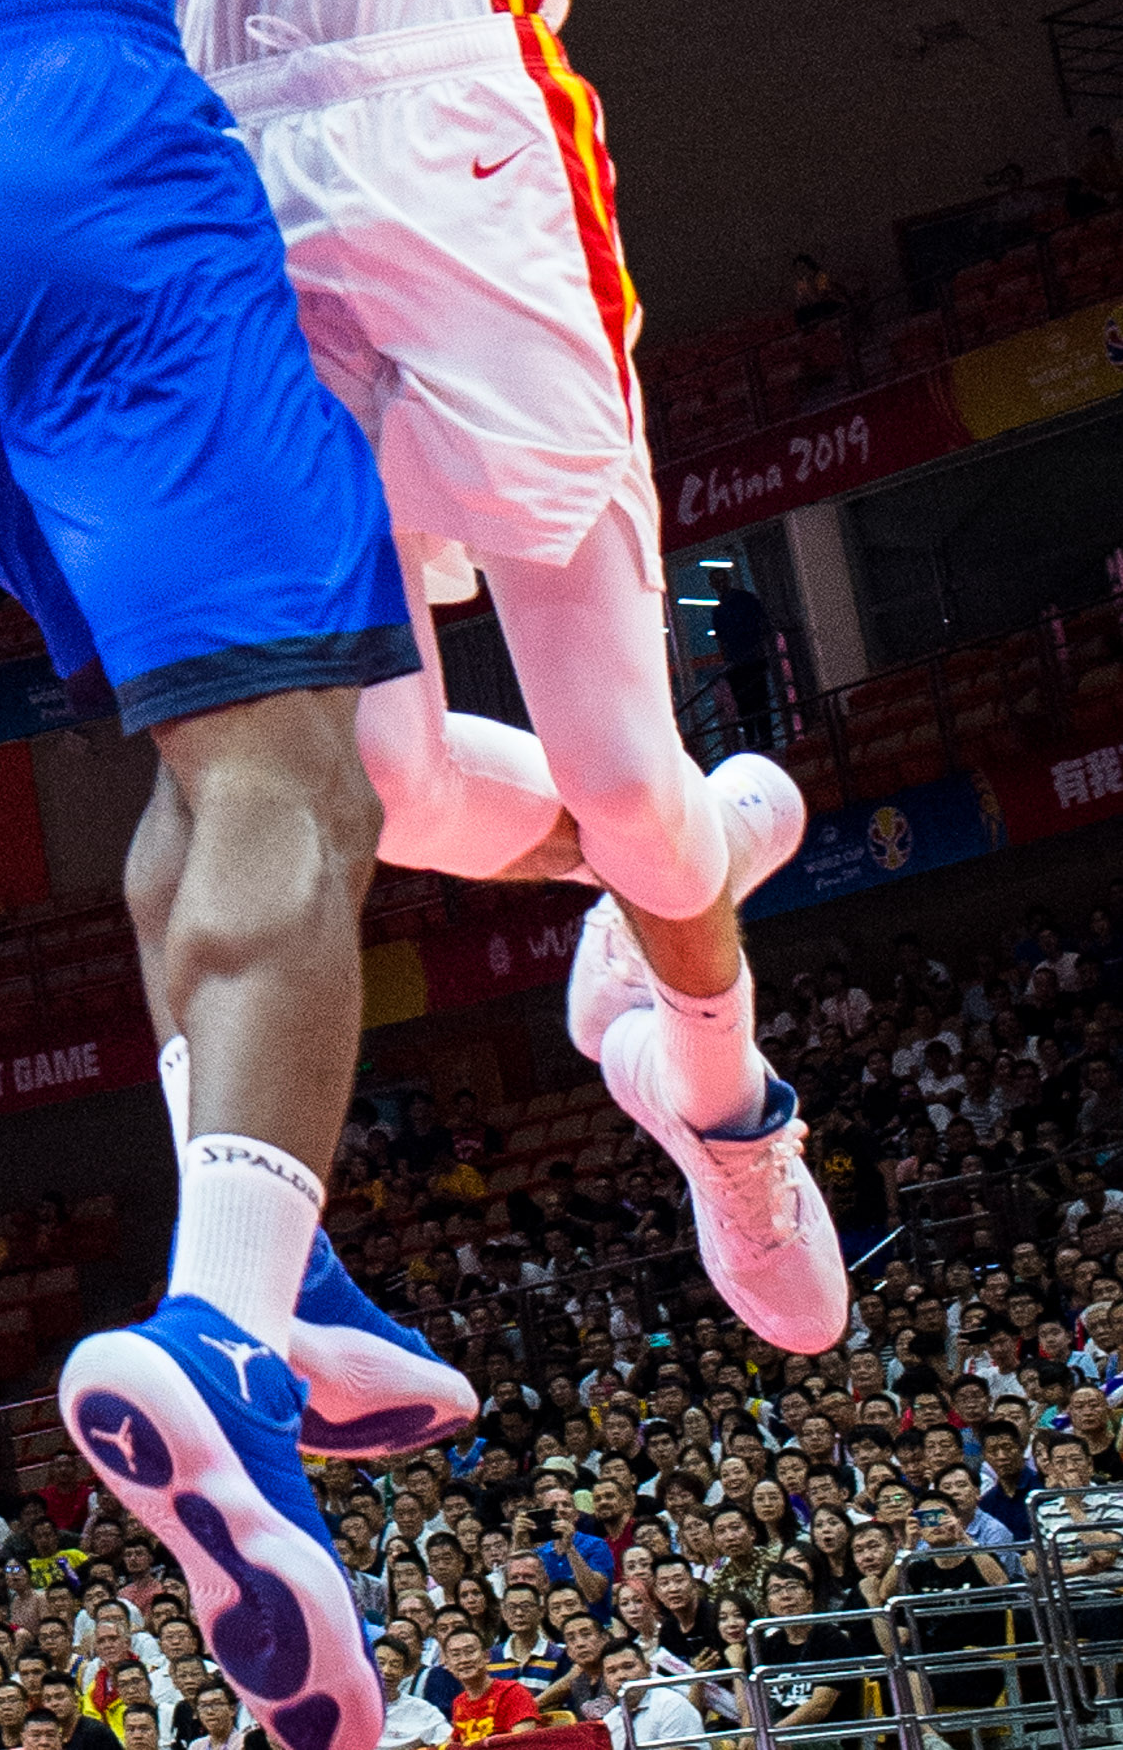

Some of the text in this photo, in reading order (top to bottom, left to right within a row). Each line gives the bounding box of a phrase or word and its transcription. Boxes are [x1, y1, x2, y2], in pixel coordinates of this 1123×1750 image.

[678, 415, 870, 525] China 2019
[13, 1042, 100, 1090] GAME
